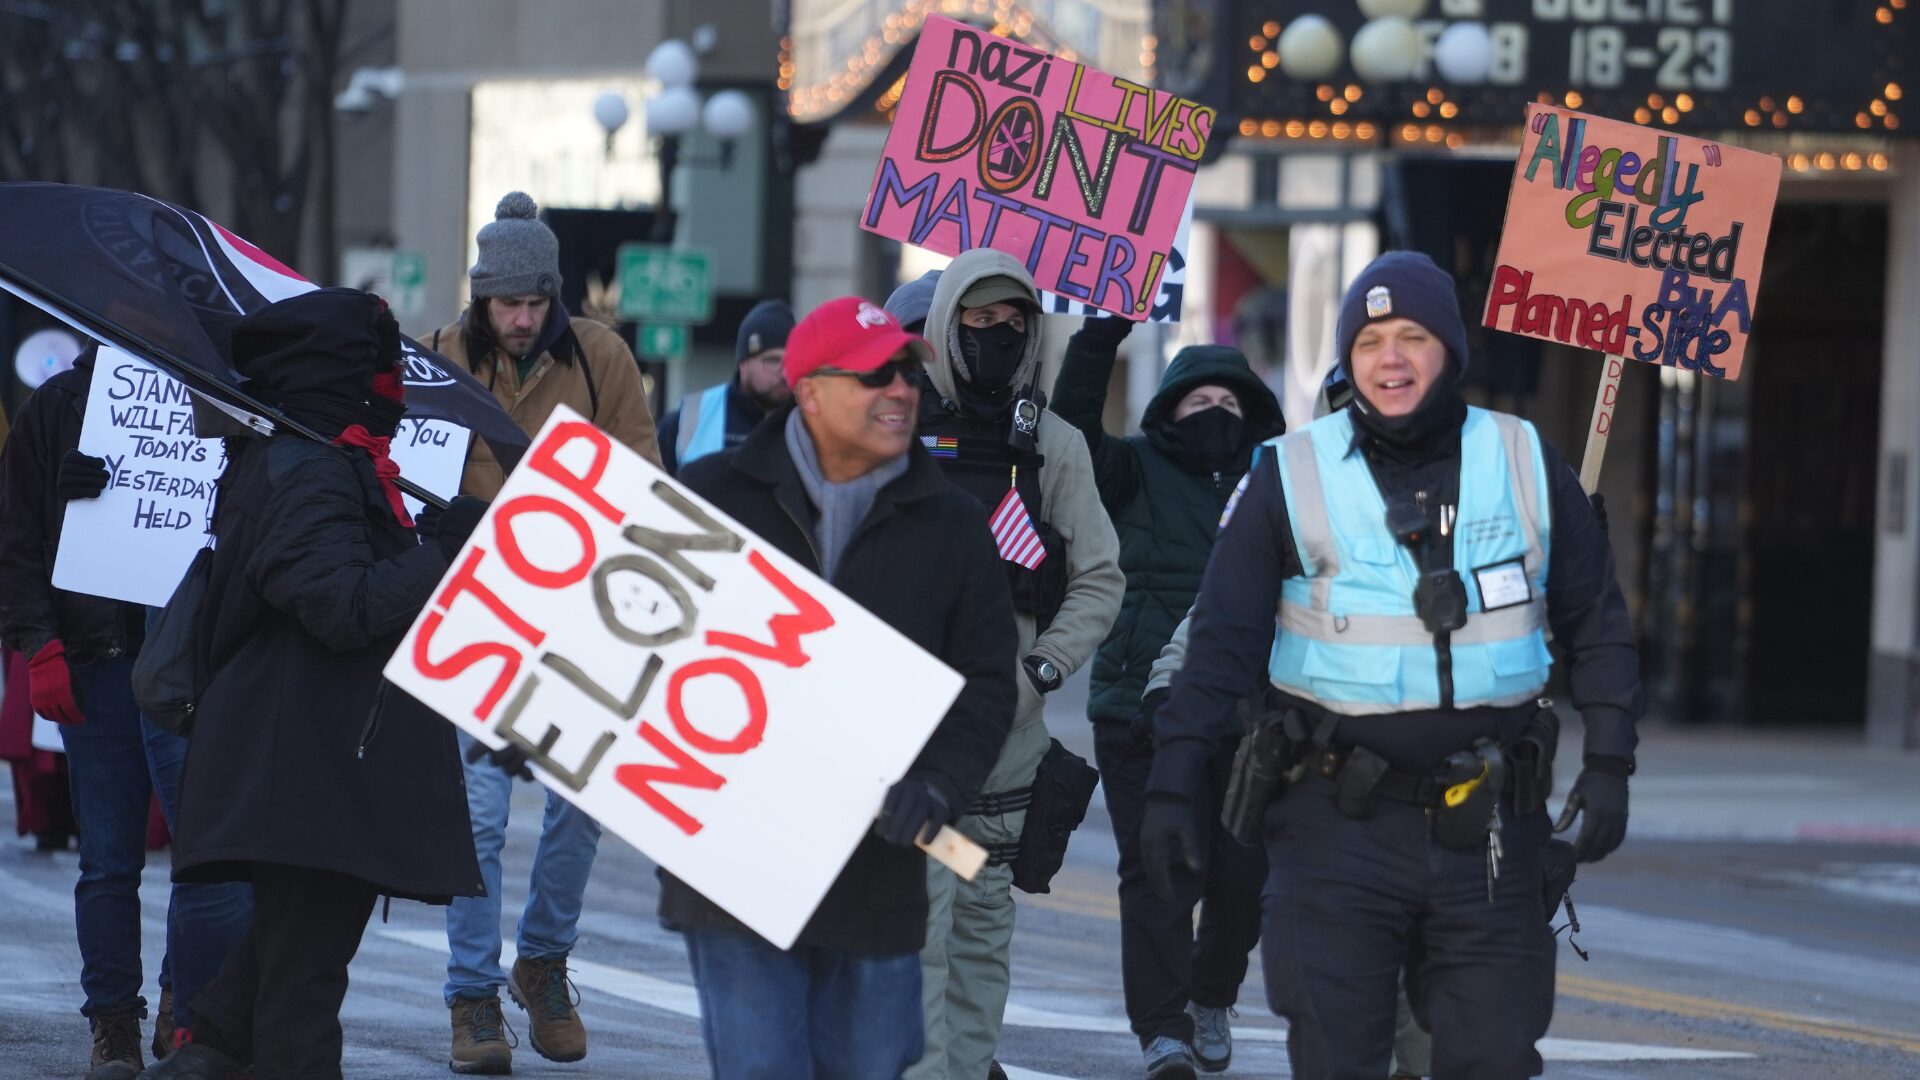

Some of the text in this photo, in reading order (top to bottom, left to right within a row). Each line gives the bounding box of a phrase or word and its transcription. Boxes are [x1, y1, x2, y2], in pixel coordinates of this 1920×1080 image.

[947, 28, 1217, 161] nazi LIVES
[1568, 26, 1731, 88] 18-23
[866, 157, 1167, 315] MATTER!
[1587, 200, 1743, 283] Elected
[1711, 278, 1752, 334] A
[110, 405, 194, 435] WILL FA
[410, 419, 450, 447] You
[134, 498, 192, 530] HELD
[412, 420, 626, 723] STOP
[494, 479, 746, 793] ELON
[614, 549, 835, 837] NOW
